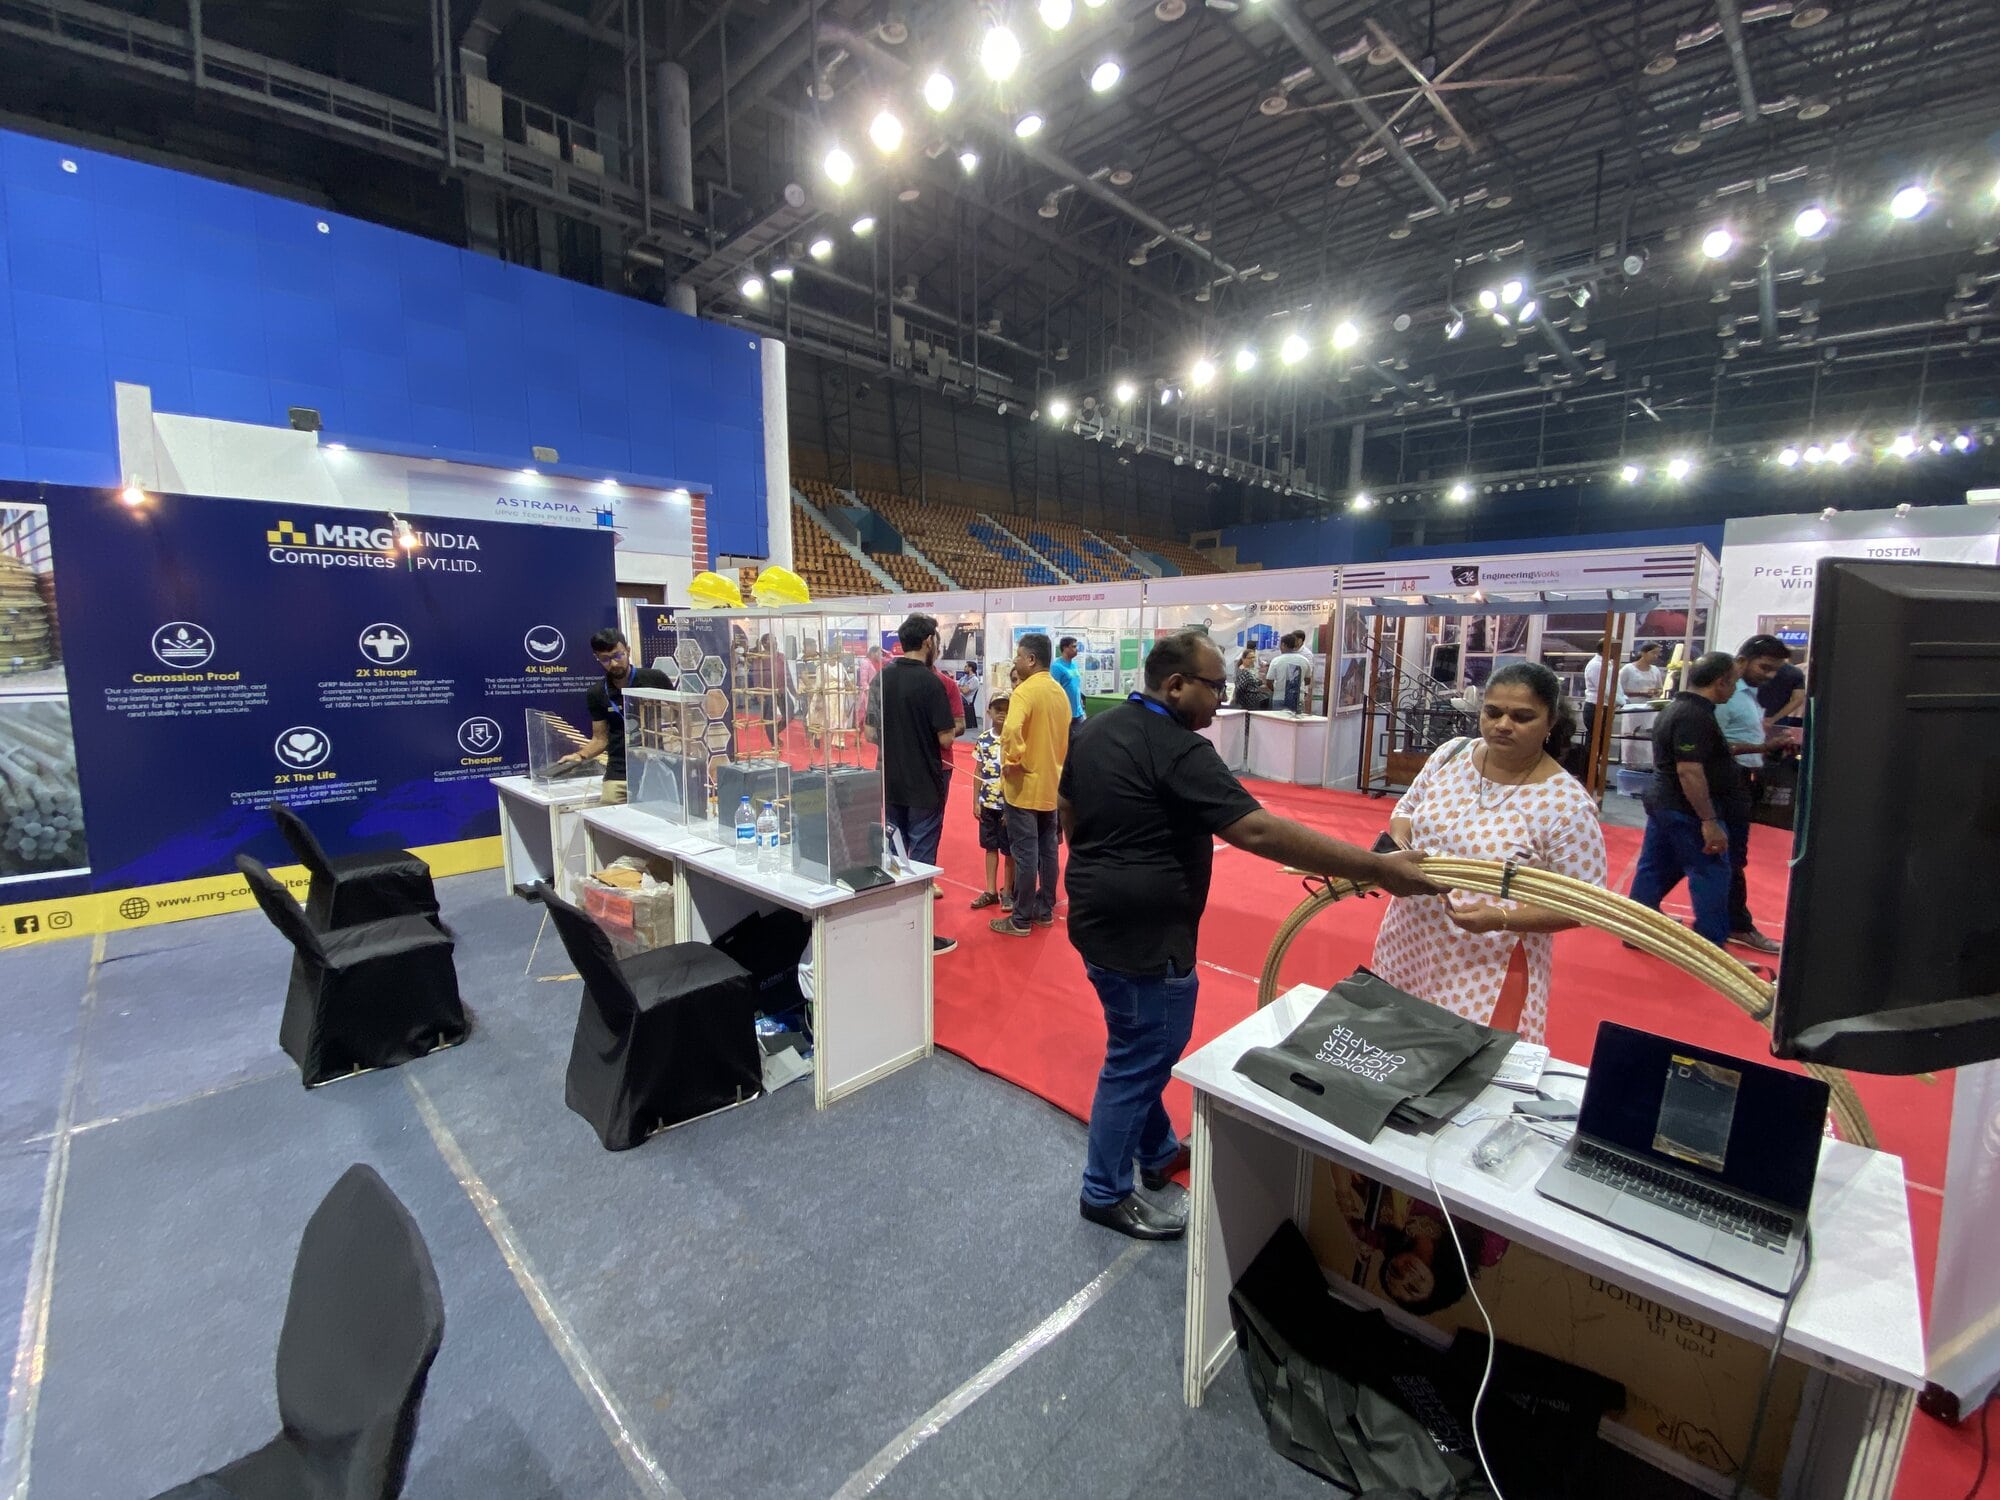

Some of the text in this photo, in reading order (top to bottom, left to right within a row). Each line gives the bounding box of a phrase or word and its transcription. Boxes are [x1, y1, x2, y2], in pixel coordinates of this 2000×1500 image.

[496, 497, 580, 513] ASTRAPIA
[315, 524, 480, 550] MRG INDIA
[1867, 548, 1921, 557] TOSTEM
[269, 548, 482, 573] Composites PVT.LTD.
[1754, 565, 1813, 577] Pre-En
[1401, 580, 1416, 592] A-8
[1780, 578, 1813, 589] Win
[207, 671, 240, 681] Proof
[356, 668, 417, 679] 2X Stronger
[539, 665, 568, 674] Lighter
[460, 756, 503, 766] Cheaper
[275, 771, 336, 784] 2X The Life
[1332, 1024, 1406, 1065] CHEAPER
[1323, 1035, 1398, 1074] LIGHTER
[1315, 1048, 1388, 1082] STRONGER
[1588, 1275, 1718, 1345] tradition
[1648, 1320, 1715, 1359] rich in
